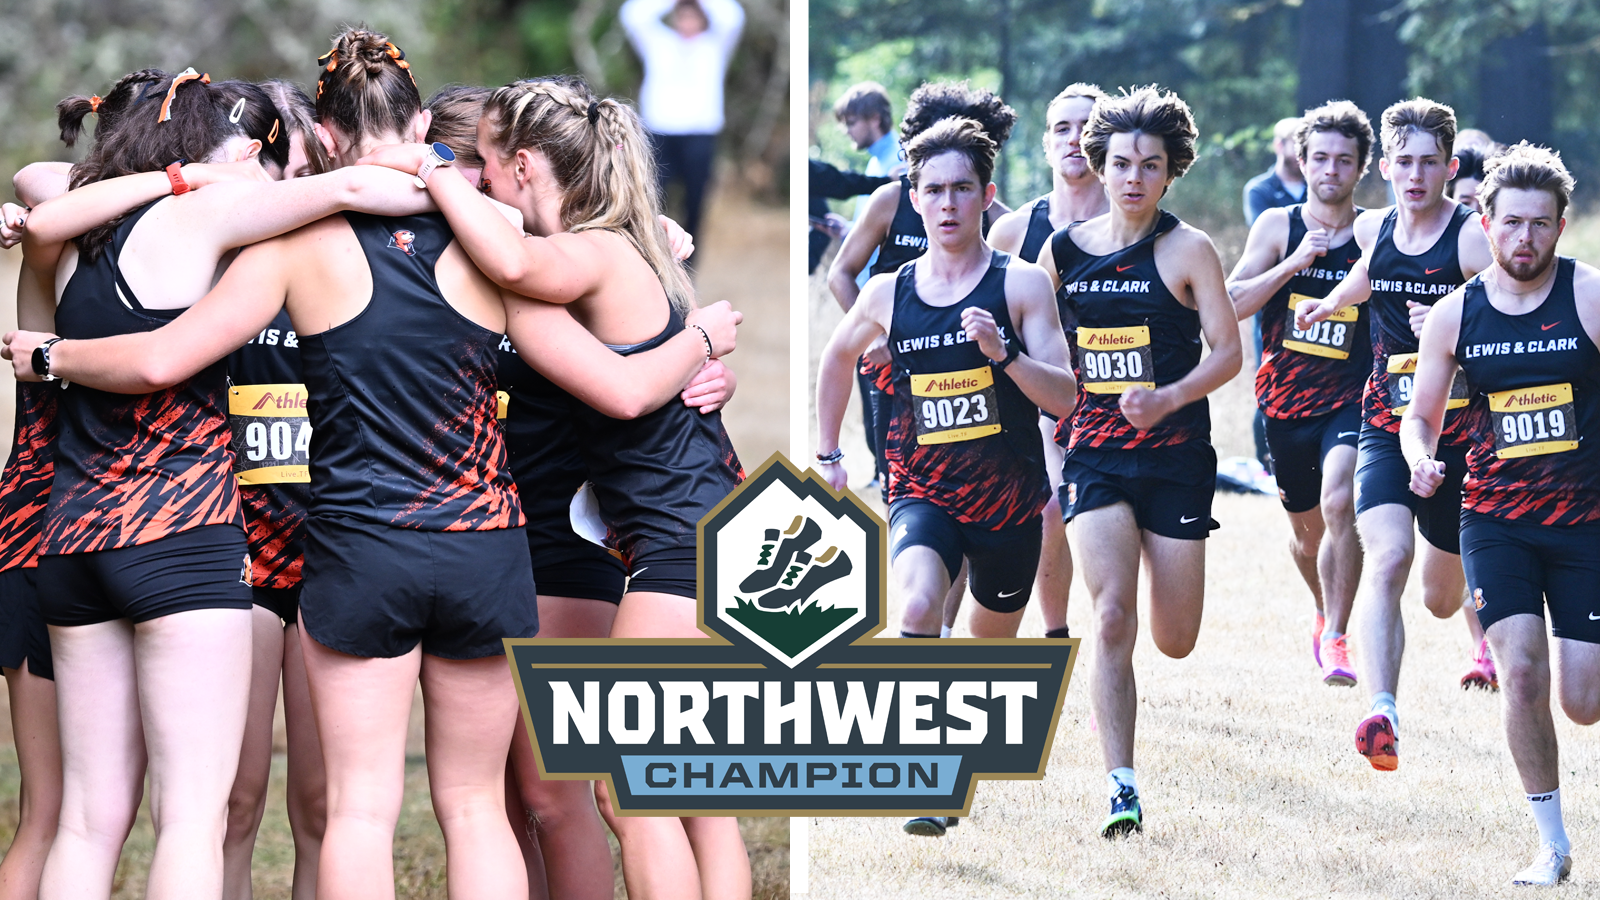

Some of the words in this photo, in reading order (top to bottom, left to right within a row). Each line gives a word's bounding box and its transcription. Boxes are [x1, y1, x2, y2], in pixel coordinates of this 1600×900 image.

[1090, 280, 1100, 292] &
[1102, 280, 1151, 293] CLARK
[1371, 279, 1403, 292] LEWIS
[1405, 281, 1413, 293] &
[1414, 282, 1456, 295] CLARK
[283, 330, 299, 348] &
[897, 334, 941, 353] LEWIS
[943, 332, 955, 346] &
[1087, 333, 1135, 345] Athletic
[1466, 342, 1511, 358] LEWIS
[1513, 341, 1526, 354] &
[1527, 337, 1578, 353] CLARK
[1084, 350, 1143, 379] 9030
[925, 377, 979, 392] Athletic
[252, 392, 308, 410] Athle
[1504, 392, 1557, 408] Athletic
[922, 393, 988, 428] 9023
[1501, 409, 1566, 443] 9019
[246, 421, 313, 462] 904
